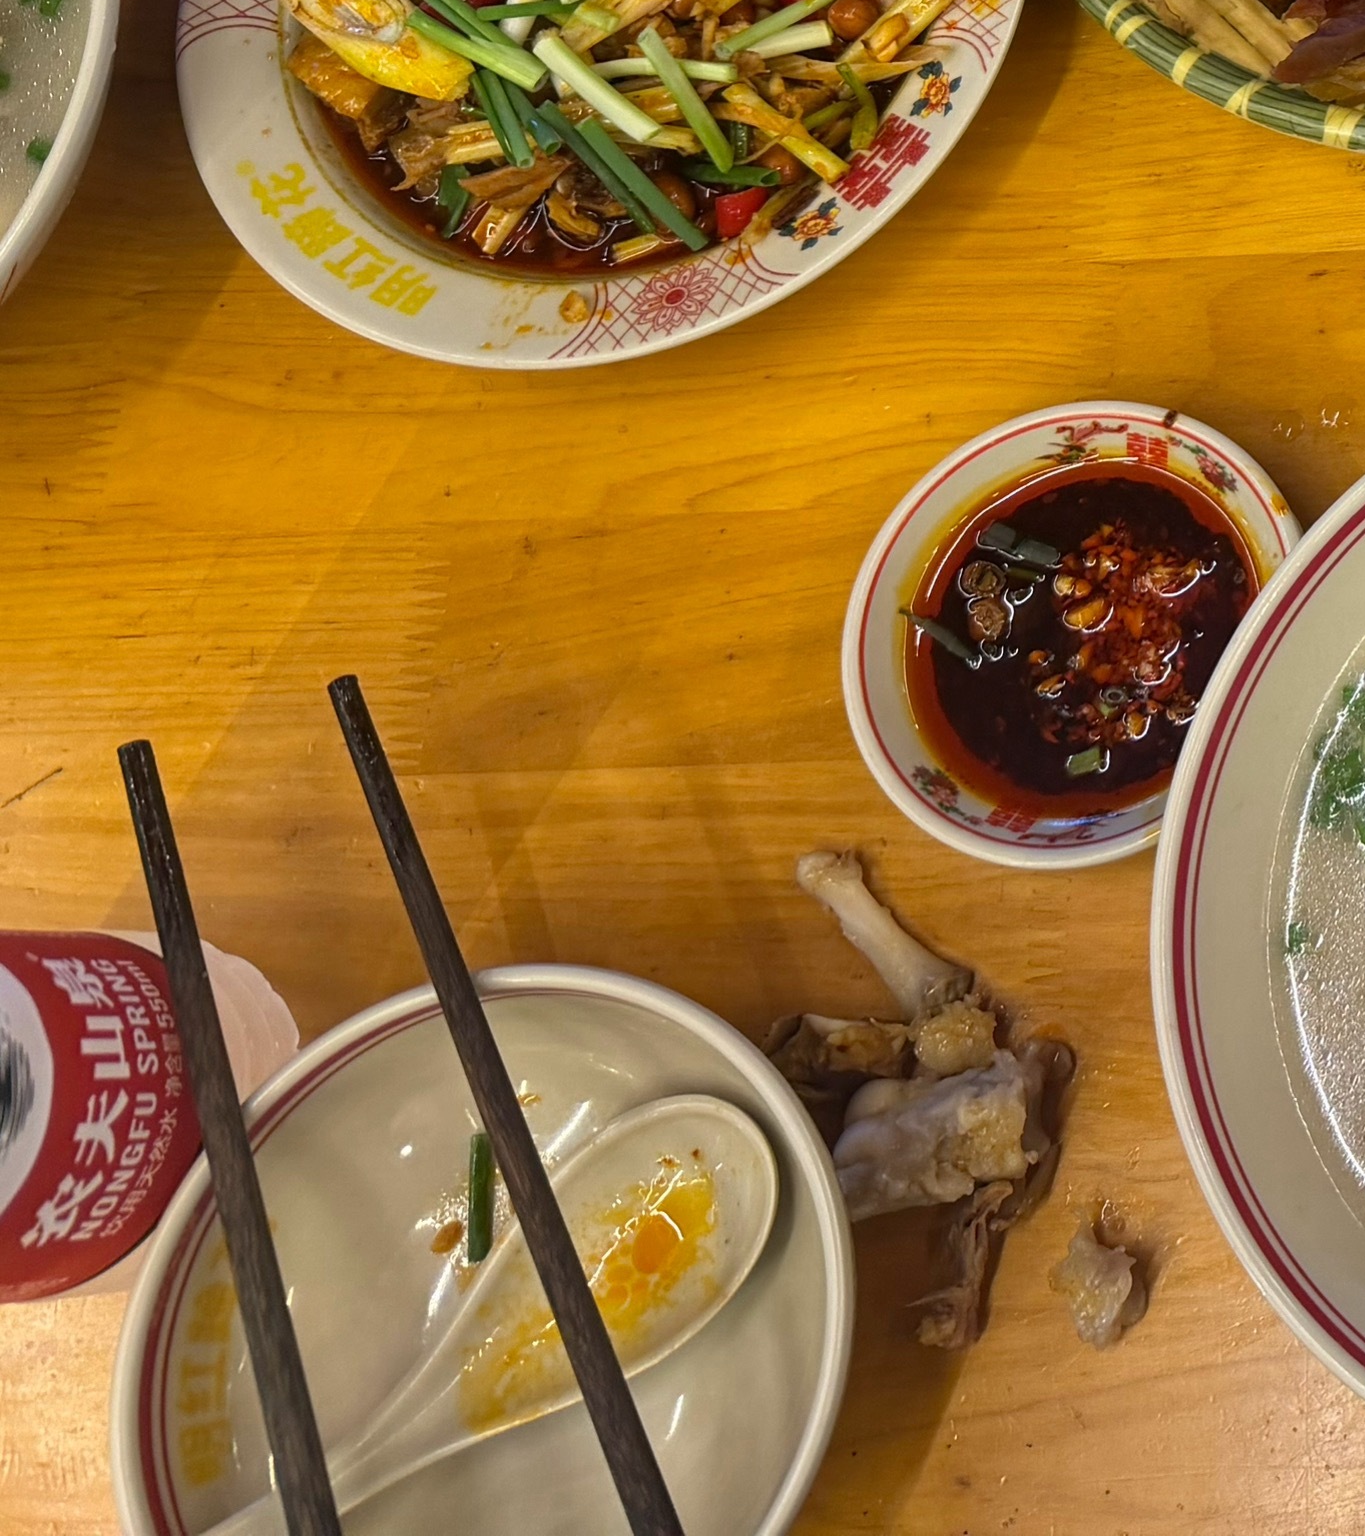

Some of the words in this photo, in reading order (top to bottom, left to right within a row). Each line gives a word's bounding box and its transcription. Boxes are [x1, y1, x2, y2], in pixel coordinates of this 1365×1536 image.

[252, 163, 438, 317] 明红蹄花
[90, 959, 159, 1074] SPRING
[20, 957, 130, 1248] 农夫山泉
[69, 1092, 157, 1241] NONGFU
[100, 1107, 177, 1237] 饮用天然水
